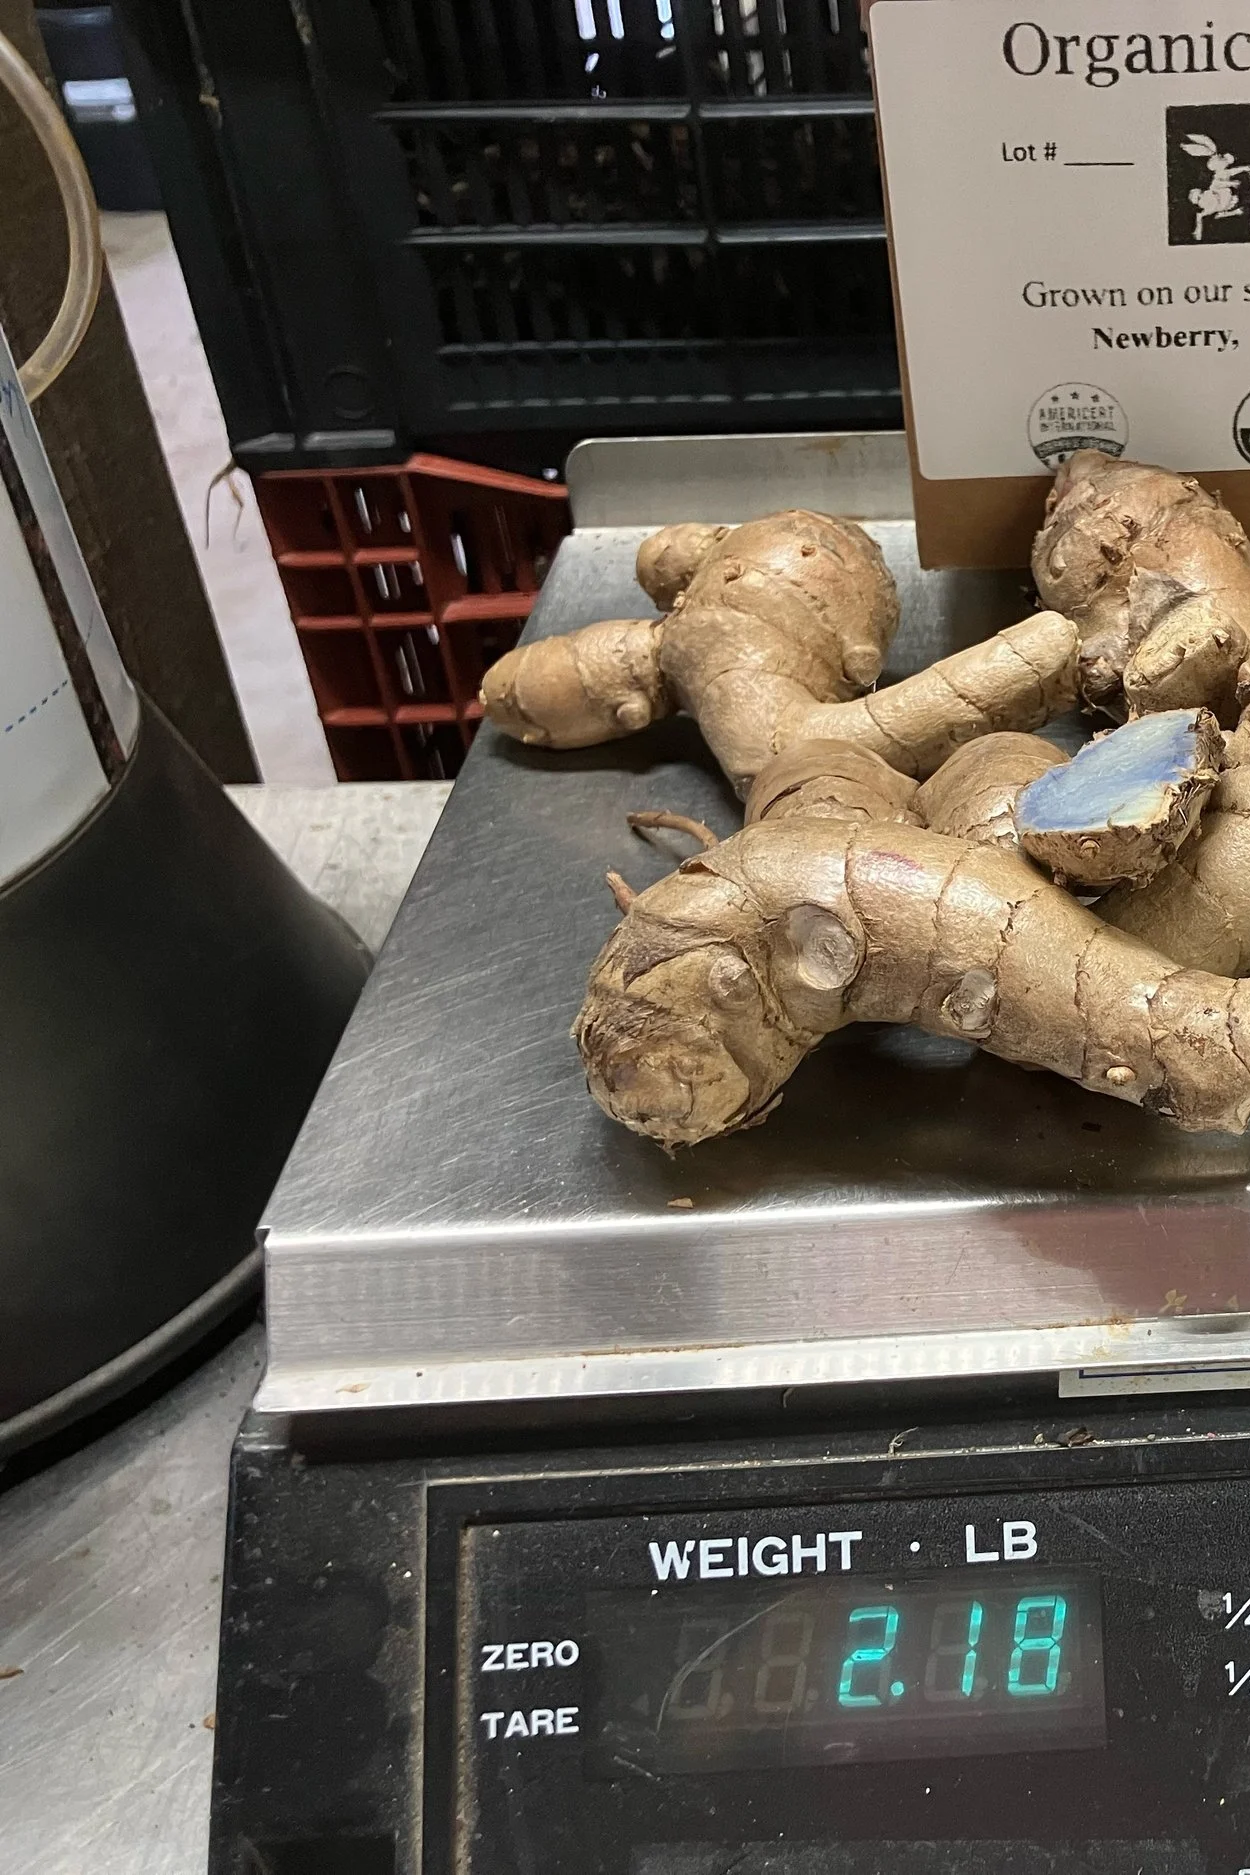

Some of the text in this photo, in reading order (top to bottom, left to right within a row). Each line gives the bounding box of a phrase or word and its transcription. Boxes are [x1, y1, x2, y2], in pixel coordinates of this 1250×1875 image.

[1002, 141, 1058, 162] Lot #
[1022, 280, 1128, 308] Grown
[1136, 285, 1174, 306] on
[1183, 284, 1233, 304] our
[1090, 325, 1240, 352] Newberry,
[1039, 405, 1115, 421] AMERICERT
[648, 1519, 1039, 1581] WEIGHT LB
[481, 1640, 580, 1673] ZERO
[837, 1594, 1069, 1708] 2.18
[481, 1707, 580, 1740] TARE
